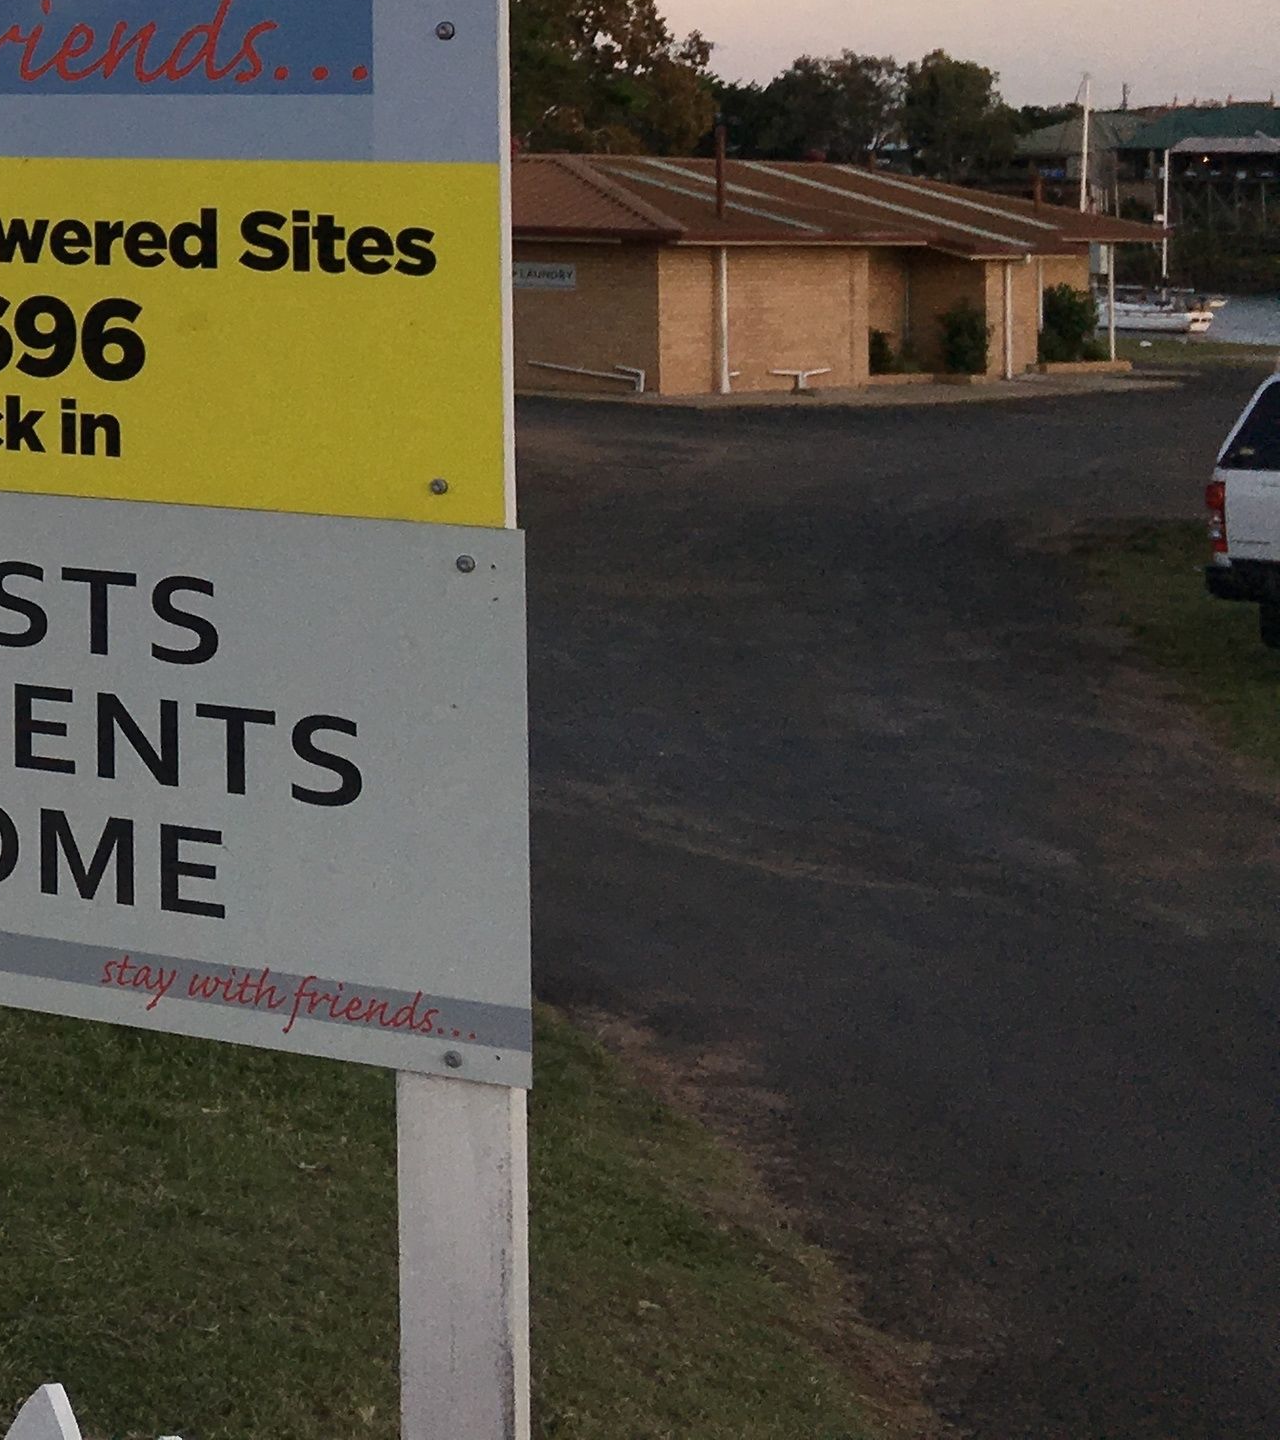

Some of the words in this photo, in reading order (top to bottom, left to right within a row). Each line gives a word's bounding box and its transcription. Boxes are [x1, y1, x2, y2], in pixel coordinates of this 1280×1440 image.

[237, 209, 438, 278] Sites
[60, 396, 122, 459] in
[101, 954, 178, 1011] stay
[187, 967, 288, 1009] with
